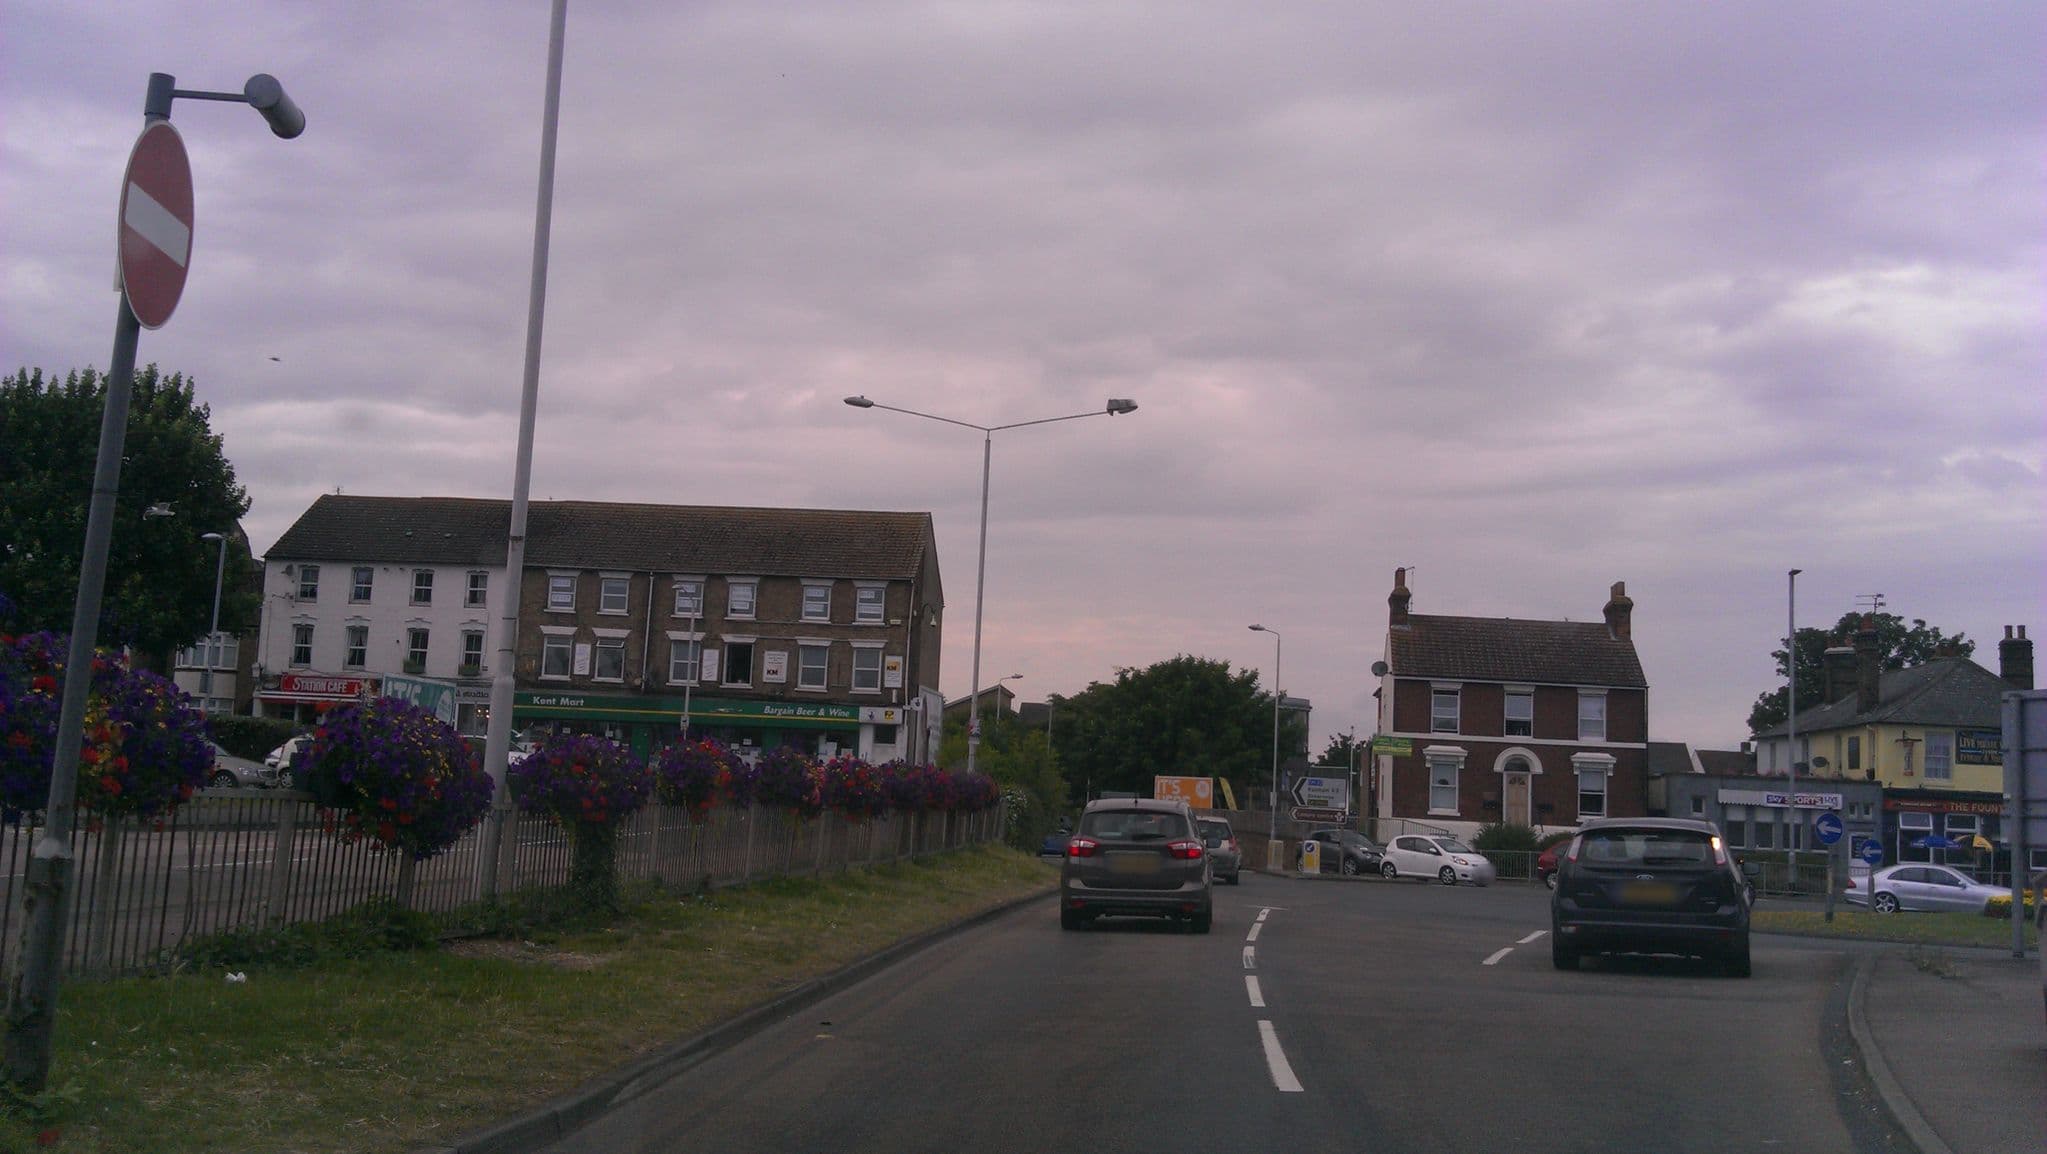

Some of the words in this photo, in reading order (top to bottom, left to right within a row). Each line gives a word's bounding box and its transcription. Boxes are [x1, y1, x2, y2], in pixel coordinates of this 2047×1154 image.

[533, 696, 556, 706] Kent
[560, 697, 584, 706] Mart
[764, 705, 794, 717] Bargain
[796, 706, 816, 716] Beer
[818, 708, 825, 716] &
[829, 708, 850, 717] Wine
[1950, 802, 1969, 811] THE
